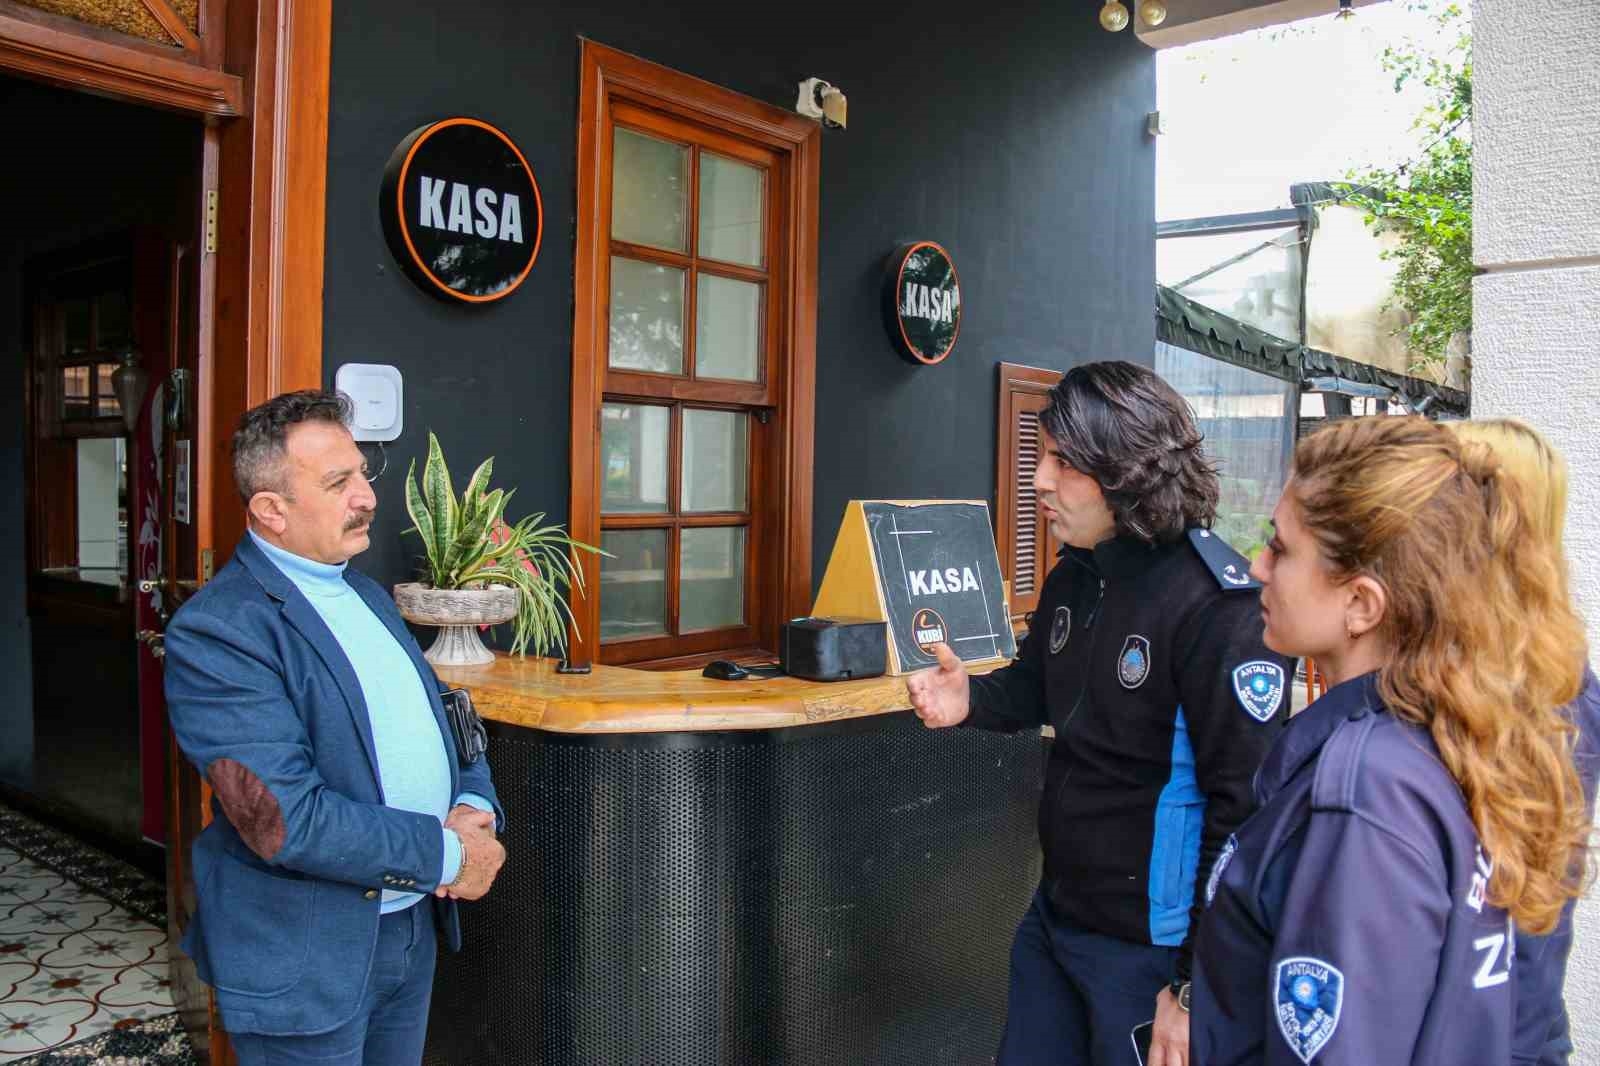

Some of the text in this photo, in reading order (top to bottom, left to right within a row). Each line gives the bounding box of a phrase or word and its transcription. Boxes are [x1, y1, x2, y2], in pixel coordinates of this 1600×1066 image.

[419, 175, 523, 244] KASA
[905, 281, 953, 323] KASA
[909, 567, 980, 596] KASA
[1240, 664, 1276, 677] ANTALYA
[1287, 963, 1329, 985] ANTALYA
